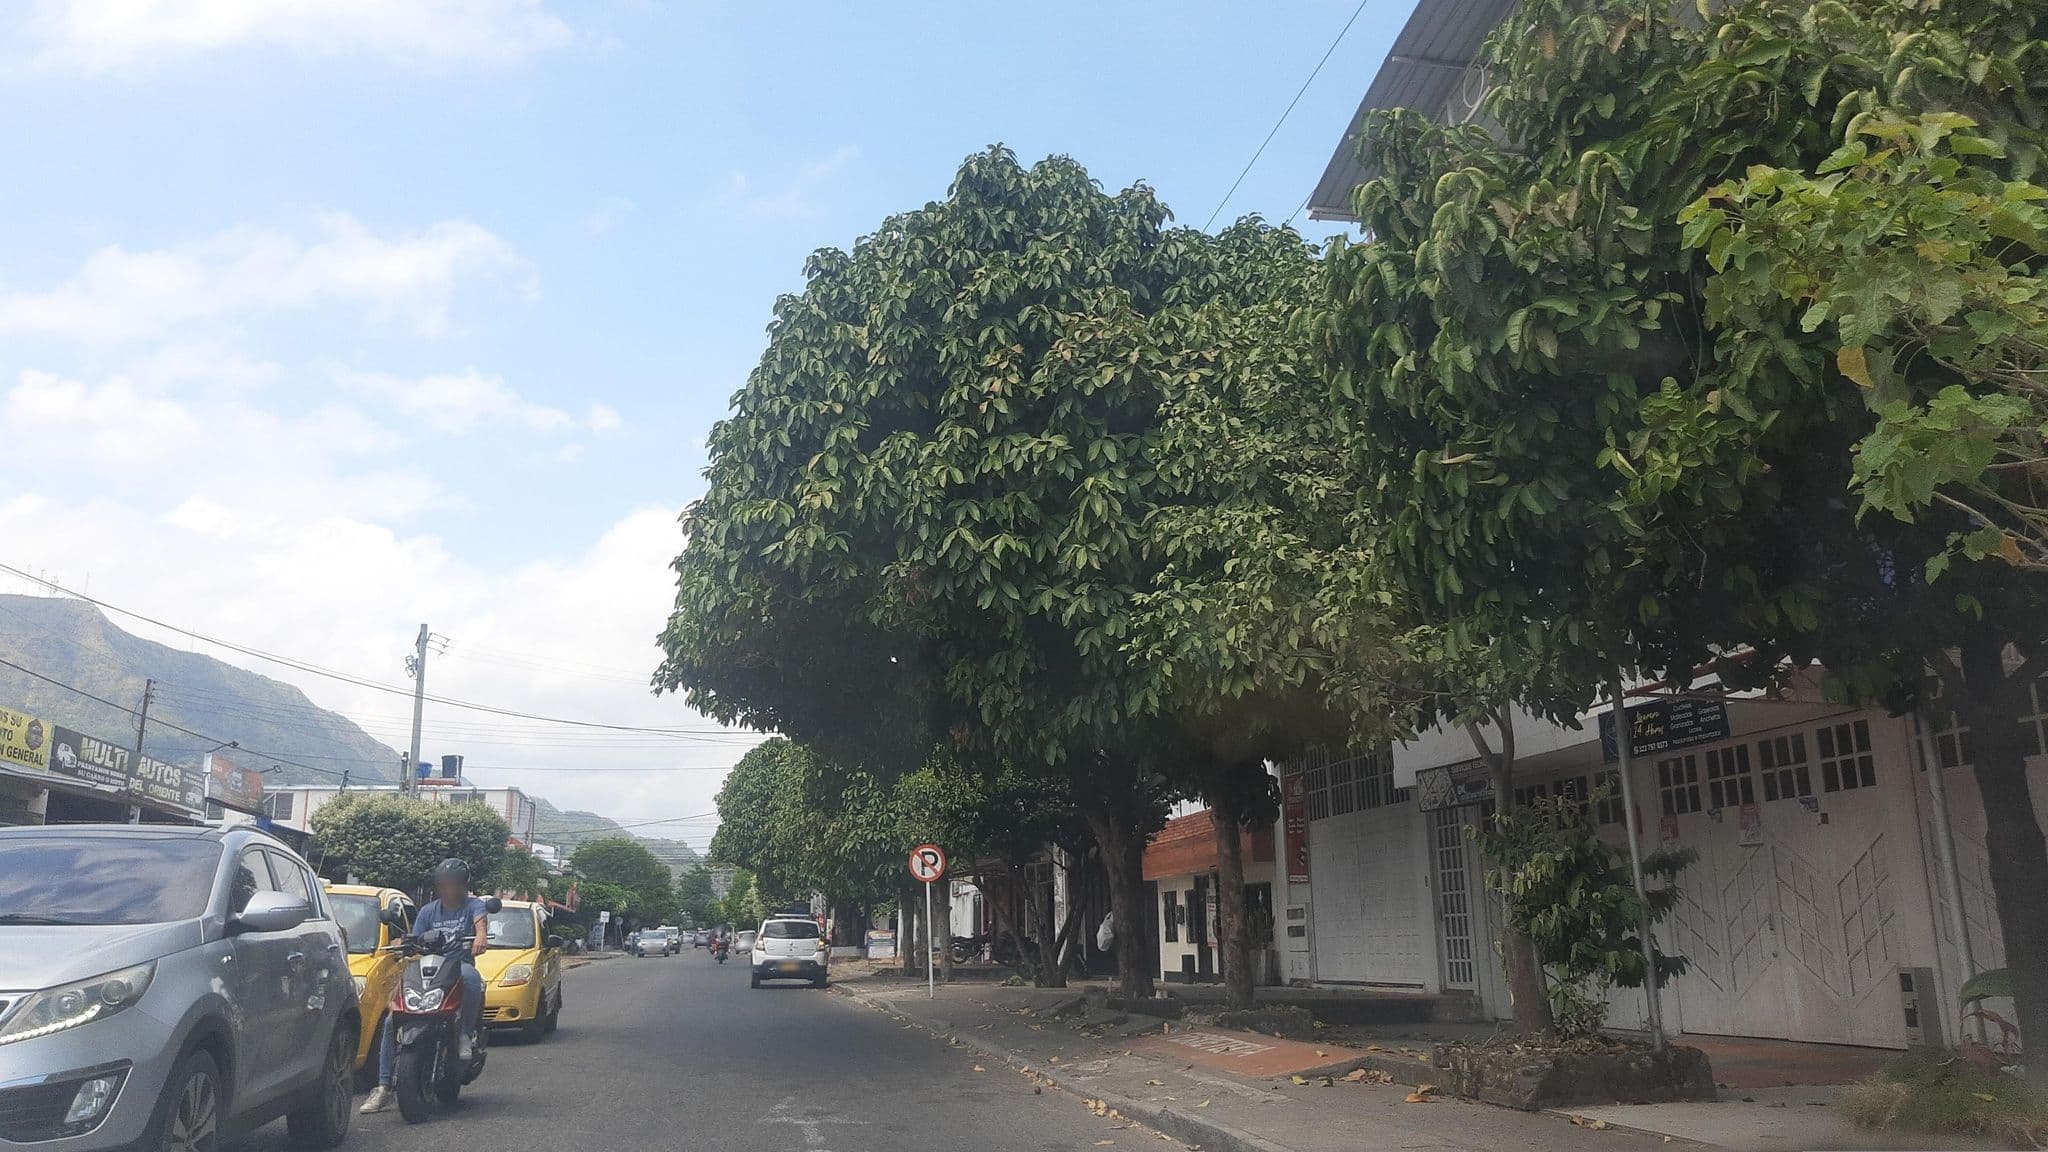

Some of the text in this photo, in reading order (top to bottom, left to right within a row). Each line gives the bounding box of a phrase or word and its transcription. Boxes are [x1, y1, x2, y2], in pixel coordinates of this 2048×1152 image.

[6, 745, 44, 766] GENERAL
[80, 737, 129, 771] MULTI
[136, 756, 181, 787] AUTOS
[129, 777, 181, 802] DEL ORIENTE
